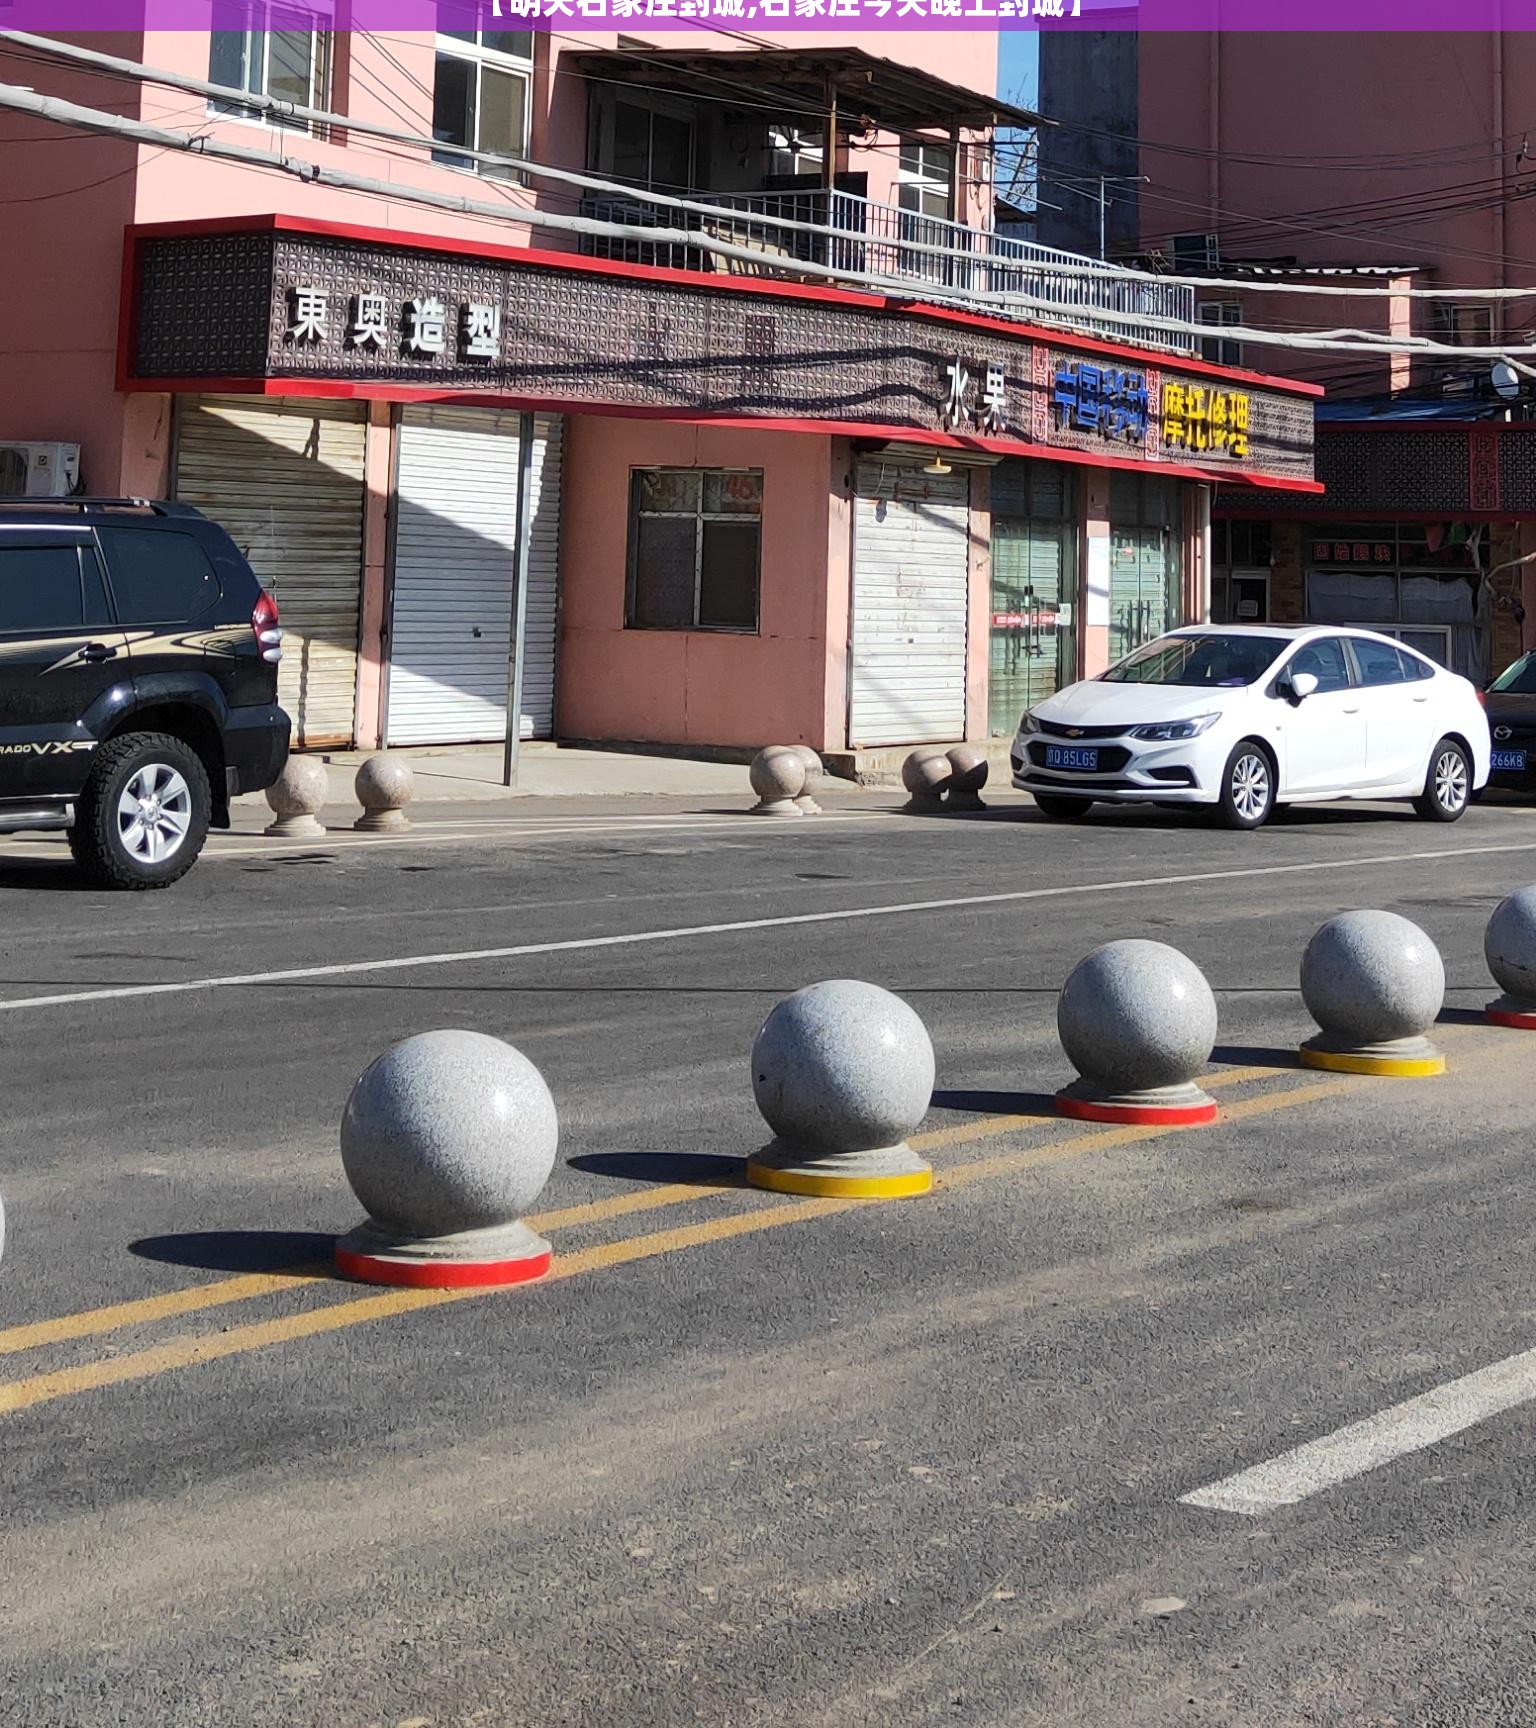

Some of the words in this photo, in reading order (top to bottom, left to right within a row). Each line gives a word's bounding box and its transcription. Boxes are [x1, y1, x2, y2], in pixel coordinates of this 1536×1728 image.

[945, 355, 1007, 431] 水果
[1055, 359, 1149, 436] 中国移动
[1163, 382, 1249, 456] 摩托修理
[31, 740, 74, 755] VX
